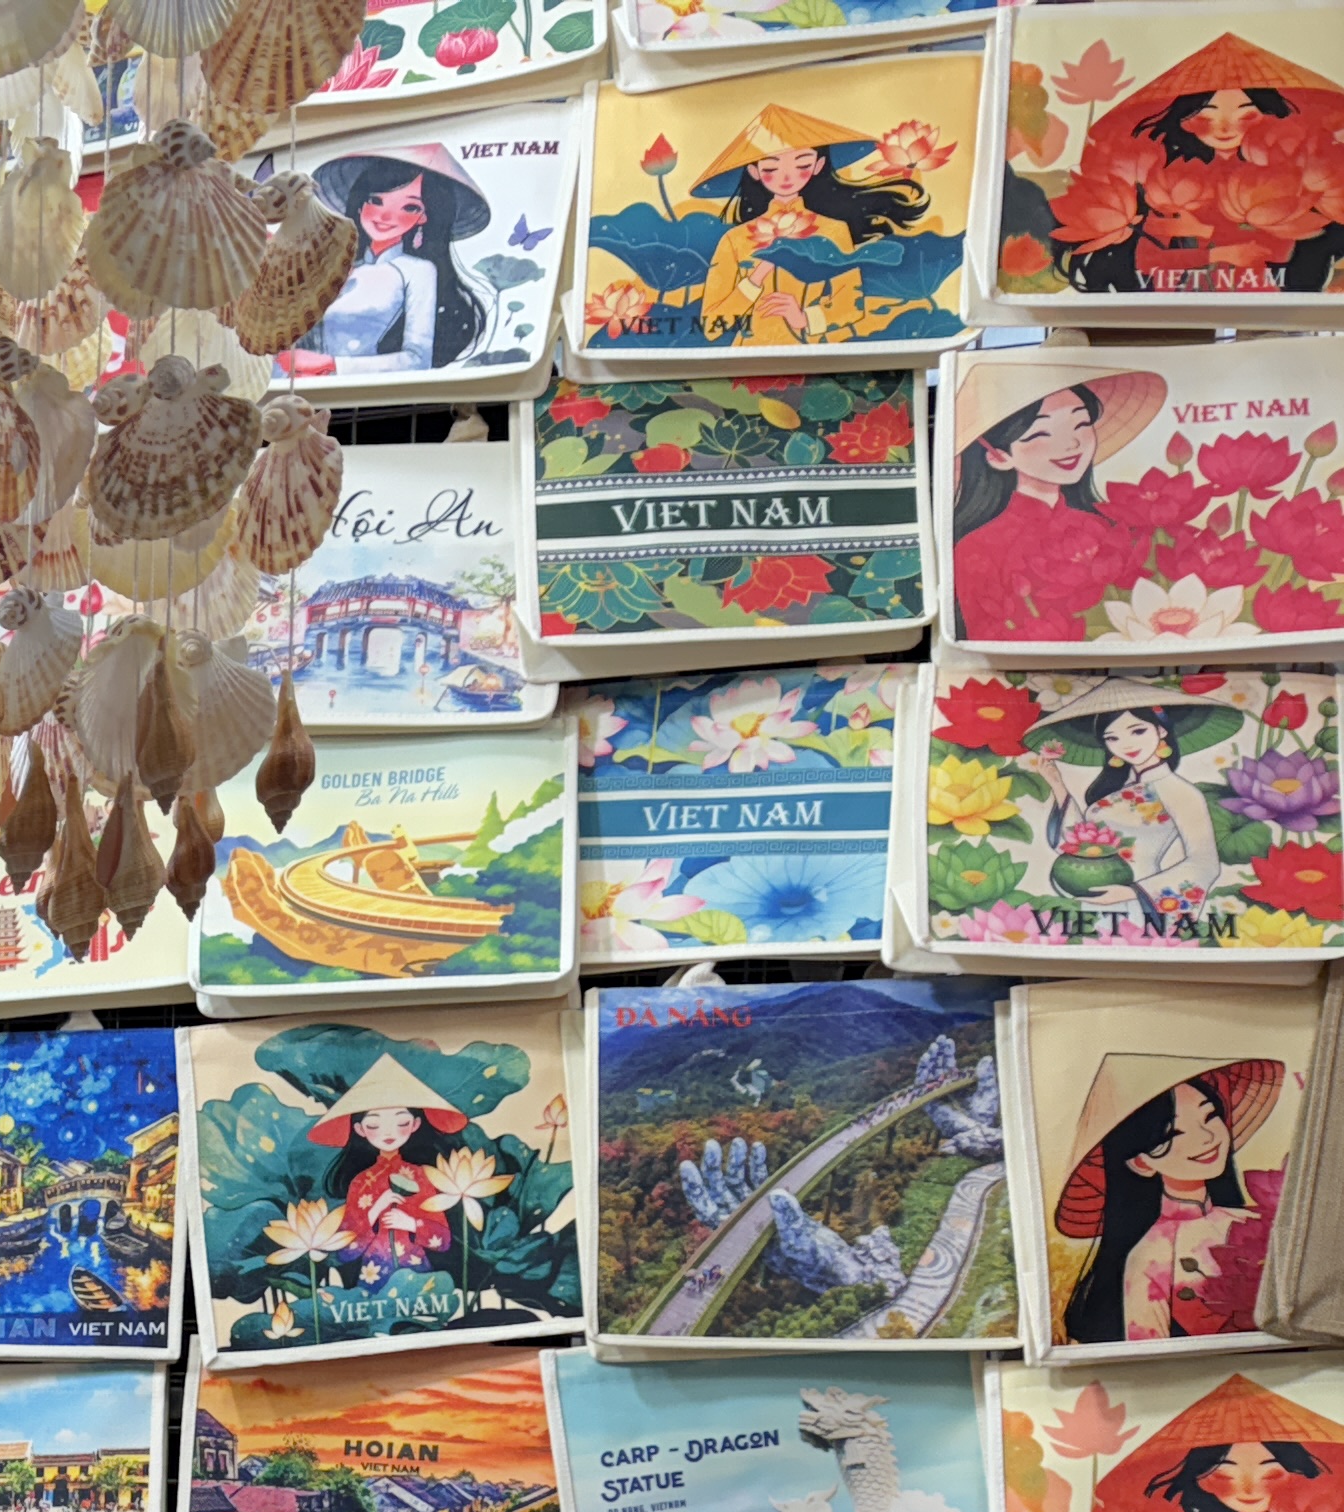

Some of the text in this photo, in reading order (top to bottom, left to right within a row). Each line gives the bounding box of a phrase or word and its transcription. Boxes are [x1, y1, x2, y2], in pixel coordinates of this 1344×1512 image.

[460, 140, 560, 160] VIET NAM
[1134, 266, 1288, 291] VIET NAM
[617, 313, 753, 337] VIET NAM
[1172, 396, 1312, 425] VIET NAM
[394, 488, 504, 547] An
[612, 496, 833, 532] VIET NAM
[320, 766, 447, 791] GOLDEN BRIDGE
[354, 784, 461, 807] Ba Na Hills
[642, 801, 824, 832] VIET NAM
[1030, 908, 1240, 941] VIET NAM
[328, 1291, 451, 1325] VIET NAM
[68, 1321, 115, 1338] VIET
[118, 1320, 167, 1338] NAM
[344, 1437, 439, 1464] HOIAN
[600, 1443, 661, 1469] CARP
[360, 1463, 421, 1476] VIET NAM
[601, 1471, 685, 1503] STATUE
